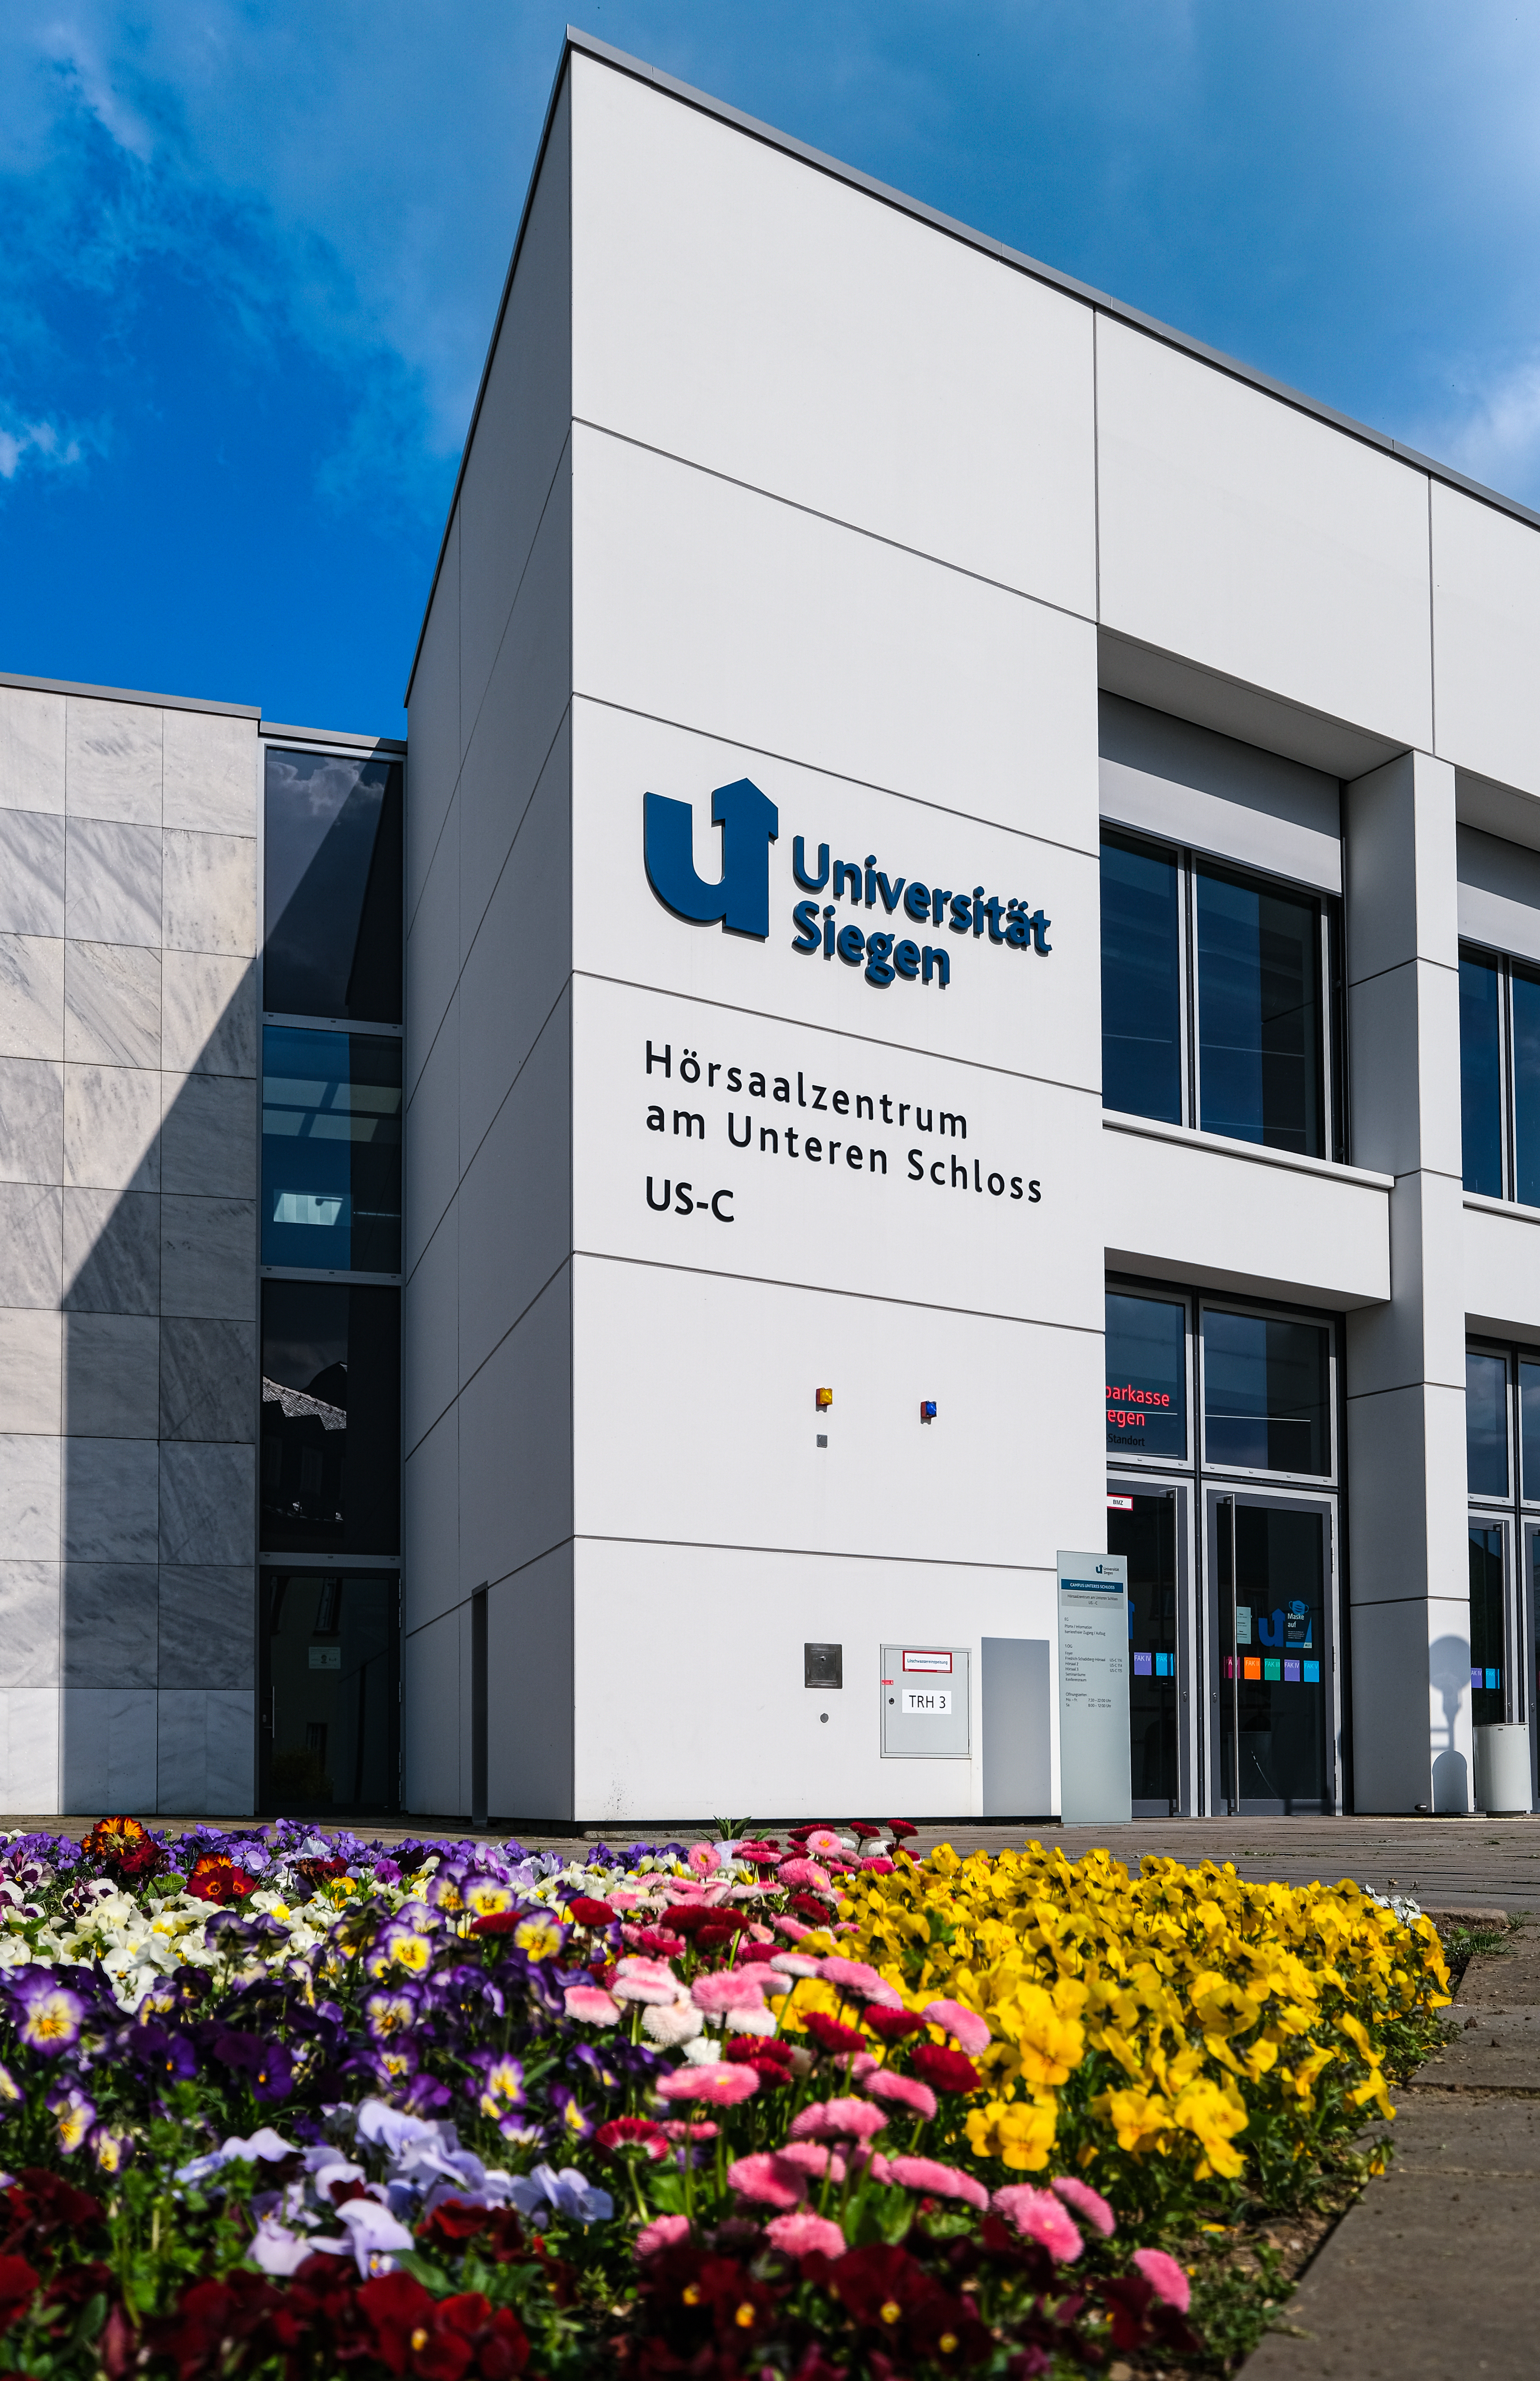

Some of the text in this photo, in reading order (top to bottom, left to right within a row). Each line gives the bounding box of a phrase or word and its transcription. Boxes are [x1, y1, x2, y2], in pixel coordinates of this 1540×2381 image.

[792, 835, 1053, 957] Universität
[791, 901, 950, 990] Siegen
[646, 1040, 967, 1139] Hörsaalzentrum
[646, 1106, 1041, 1203] am Unteren Schloss
[646, 1176, 734, 1222] US-C
[909, 1695, 946, 1709] TRH 3
